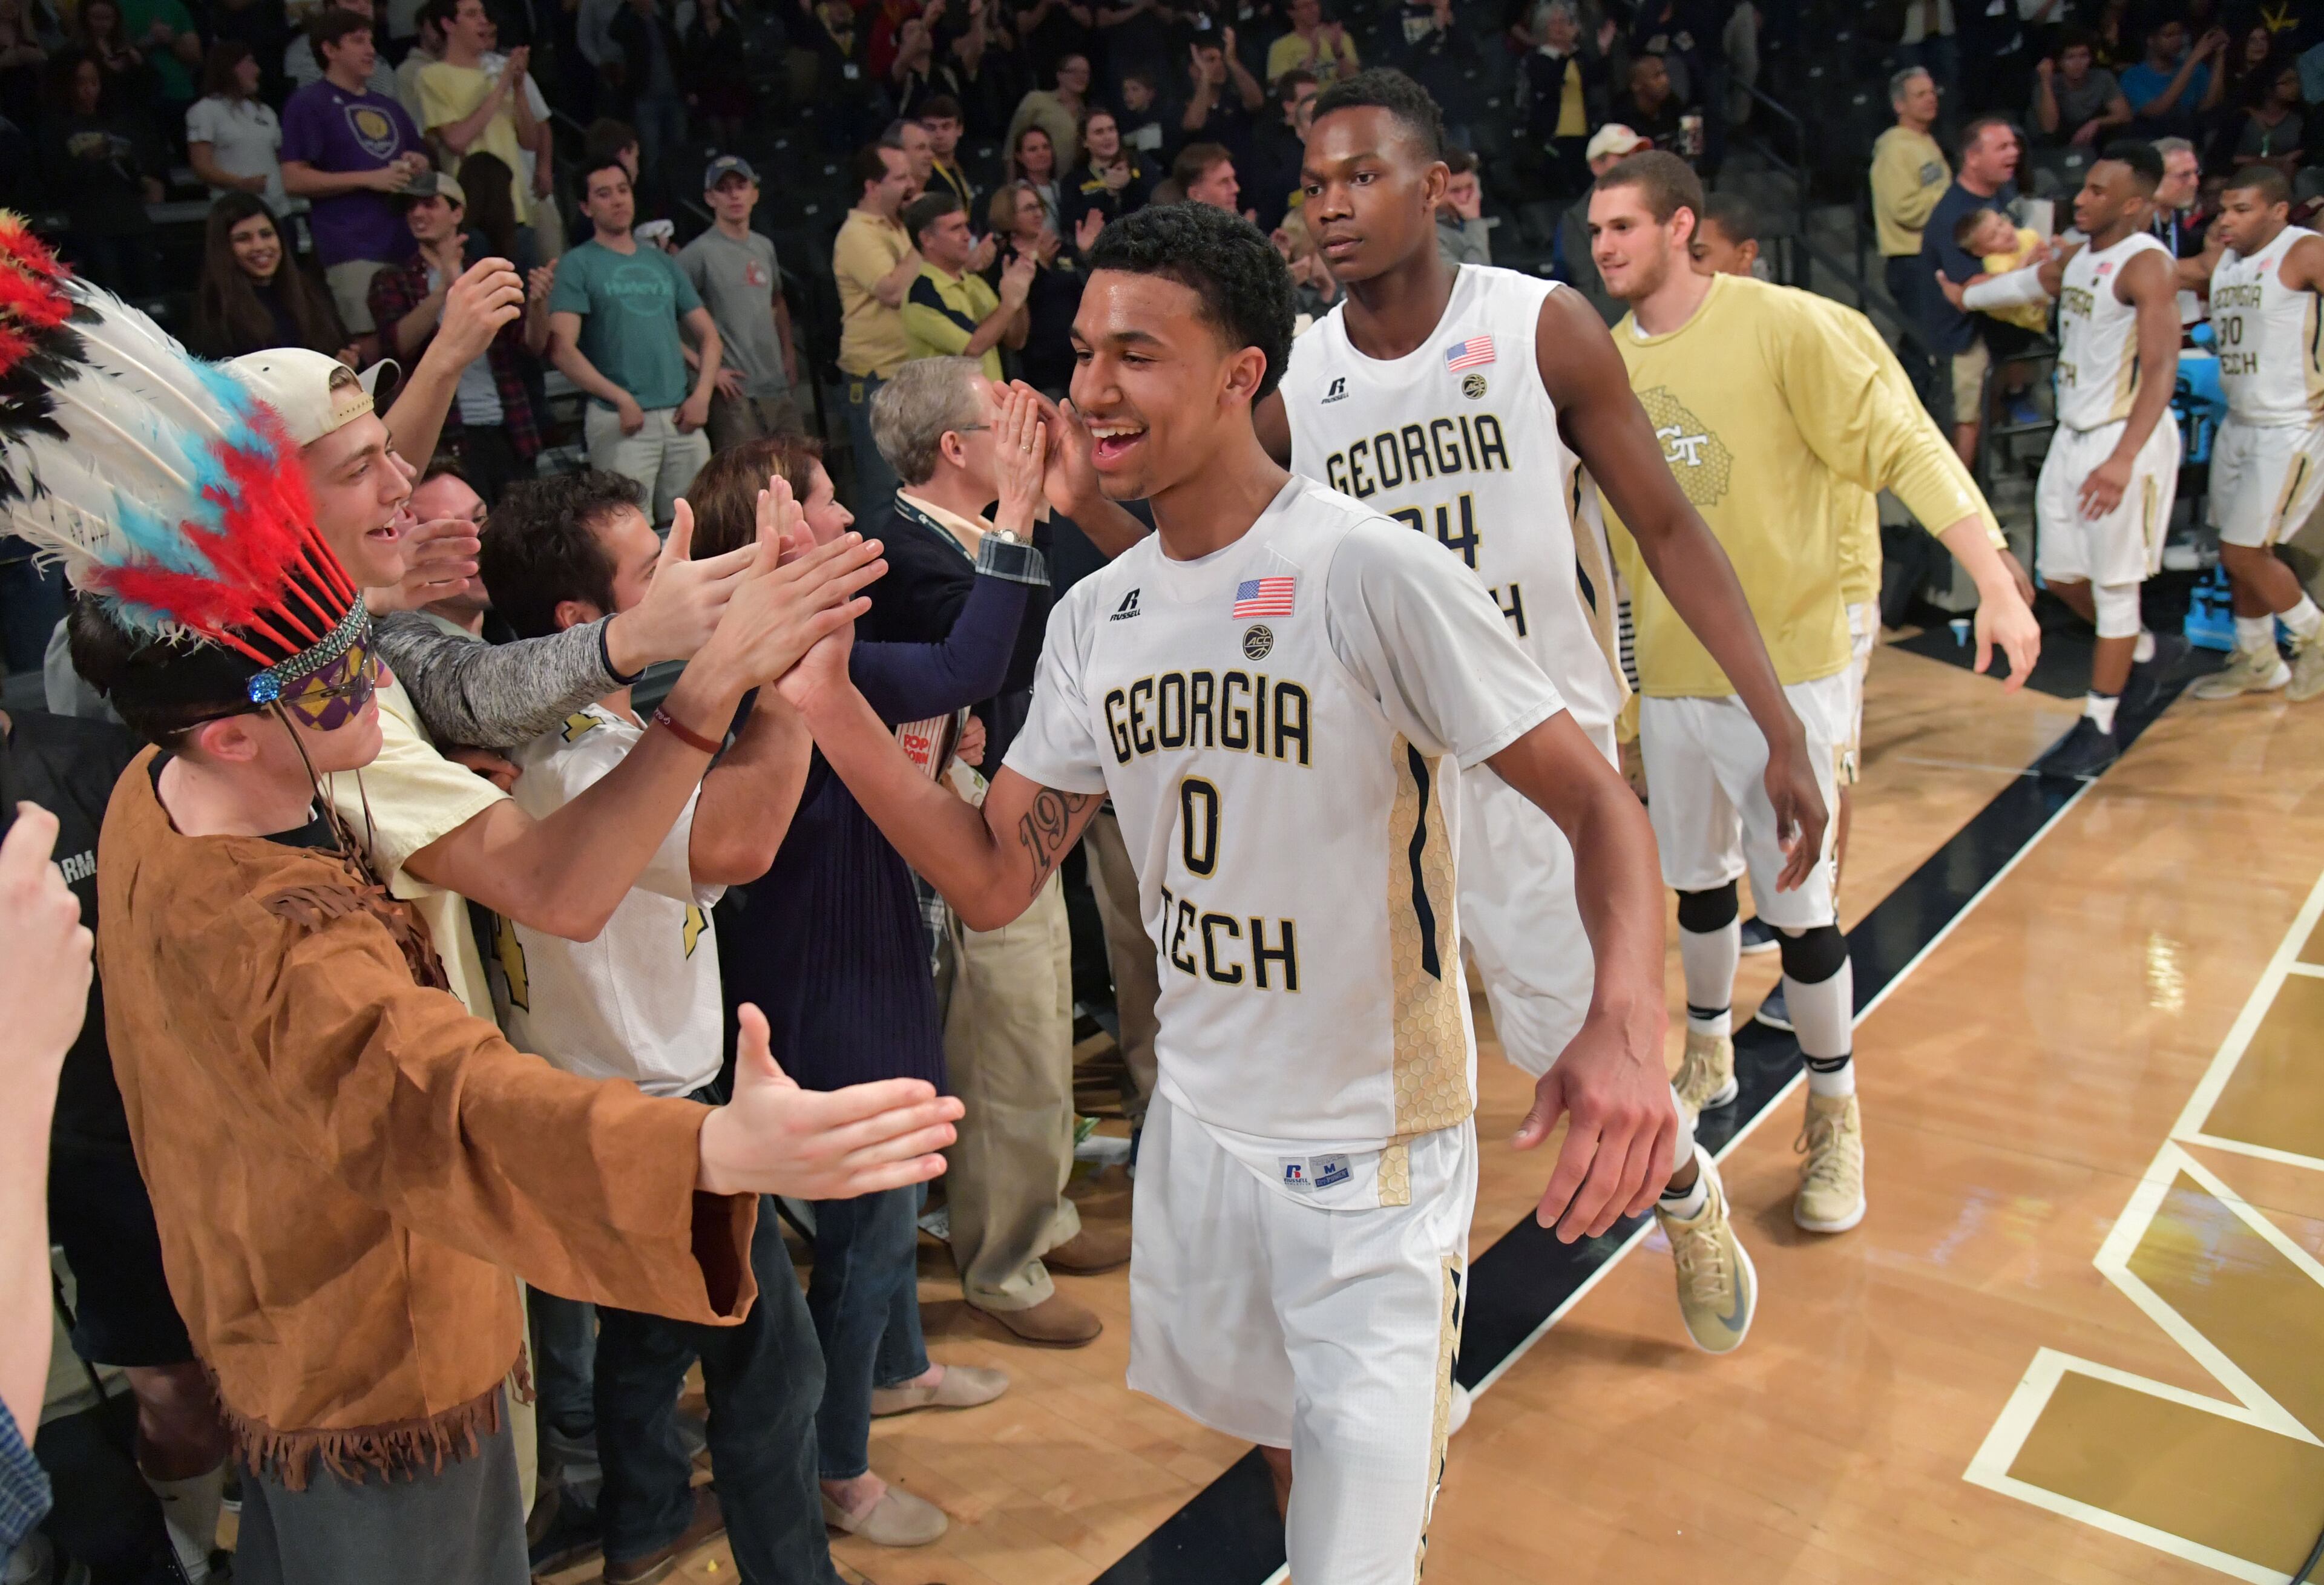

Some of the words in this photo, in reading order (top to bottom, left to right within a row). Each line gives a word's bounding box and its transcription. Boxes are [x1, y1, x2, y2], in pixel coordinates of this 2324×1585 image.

[2220, 352, 2258, 375] ECH
[1321, 392, 1349, 405] RUSSELL
[1326, 414, 1512, 500] GEORGIA
[1109, 608, 1140, 622] RUSSELL
[1247, 635, 1272, 646] ACC
[1104, 668, 1313, 769] GEORGIA
[904, 733, 929, 750] POP
[1180, 774, 1222, 880] 0
[61, 849, 97, 884] RM
[1161, 885, 1301, 994] TECH
[1324, 1163, 1336, 1174] M
